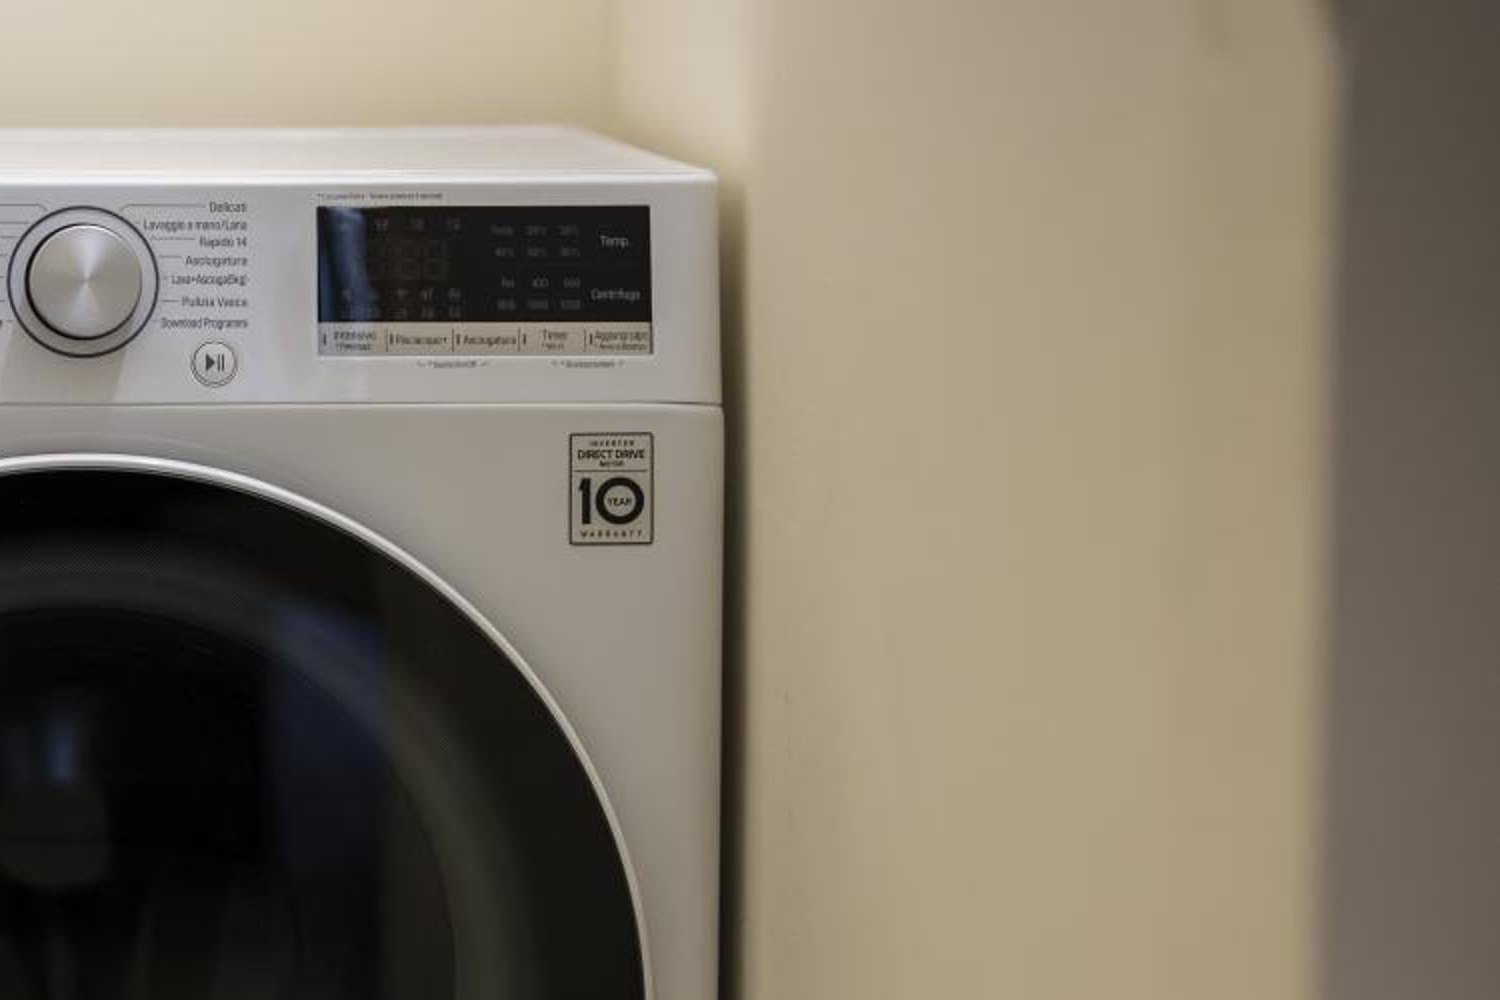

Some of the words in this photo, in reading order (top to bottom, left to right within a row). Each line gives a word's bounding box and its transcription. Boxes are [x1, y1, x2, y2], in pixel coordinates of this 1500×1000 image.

[578, 449, 613, 460] DIRECT
[615, 449, 645, 460] DRIVE
[579, 477, 645, 525] 10
